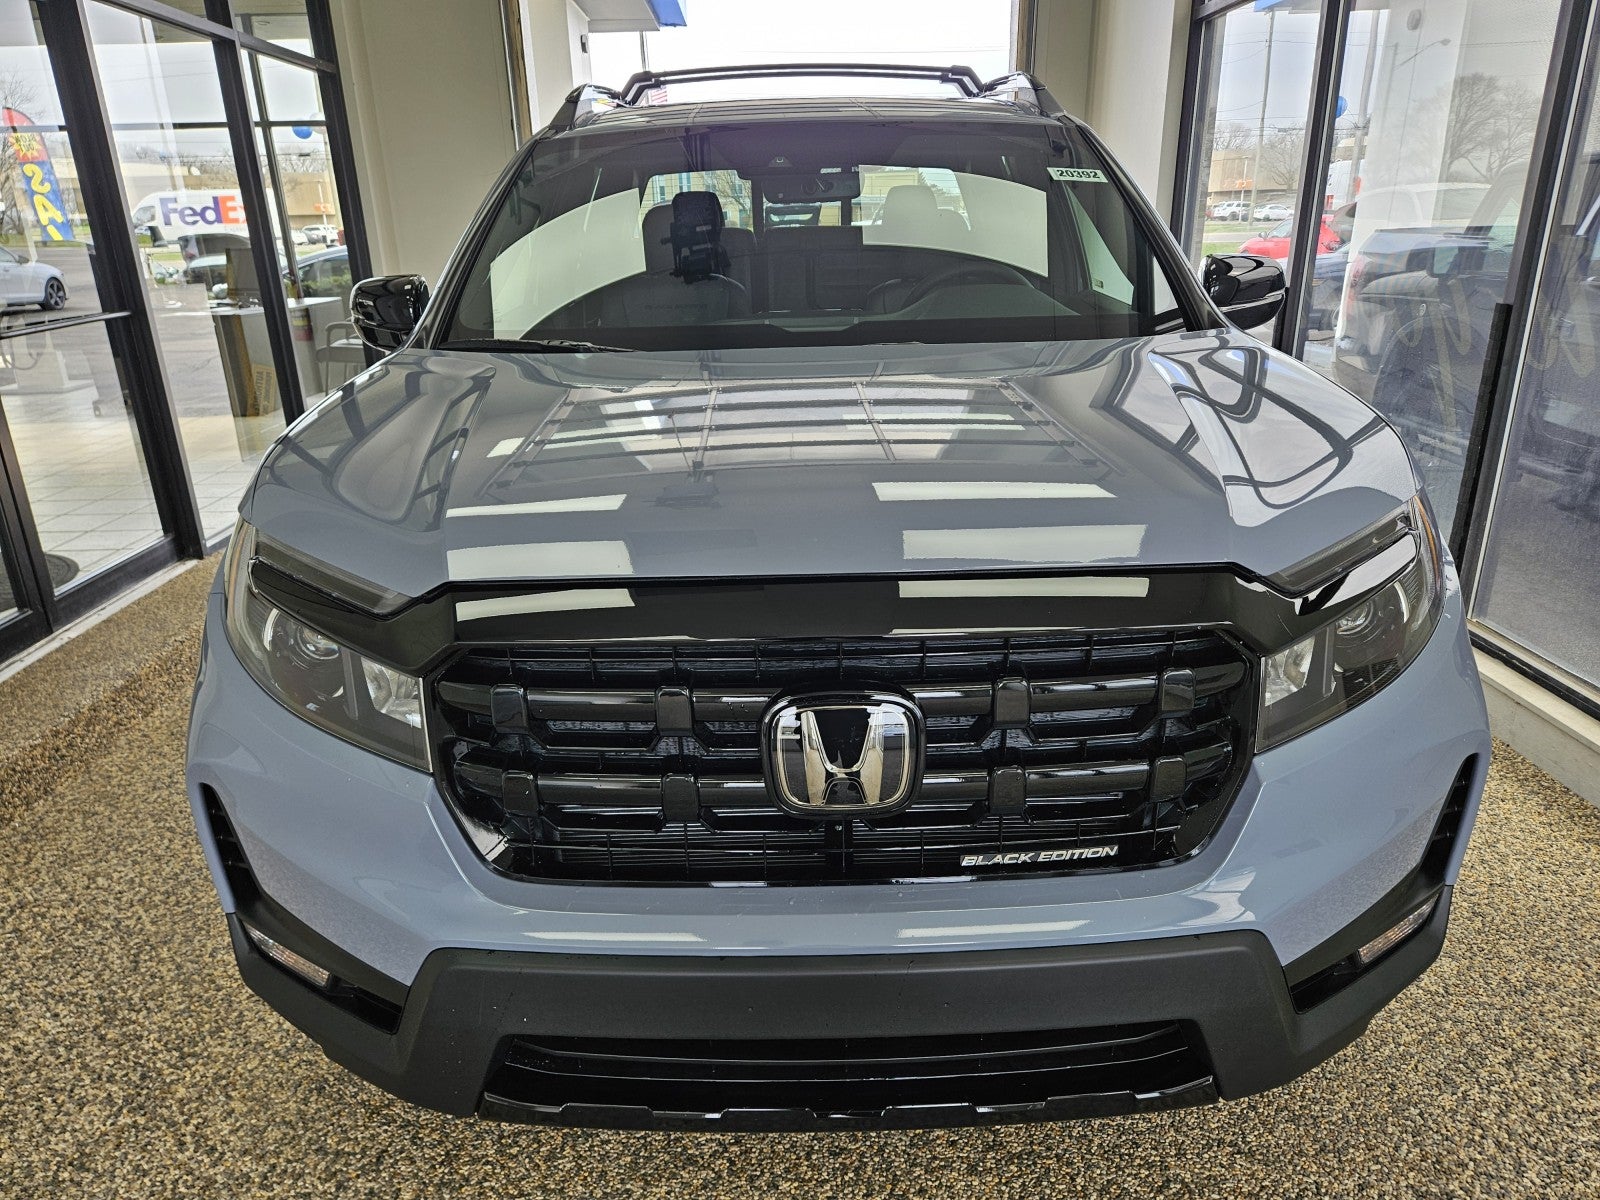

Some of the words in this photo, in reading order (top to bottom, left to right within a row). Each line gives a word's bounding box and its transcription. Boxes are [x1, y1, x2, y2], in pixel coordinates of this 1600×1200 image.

[1056, 169, 1100, 179] 20392
[961, 852, 1036, 867] BLACK
[1037, 845, 1119, 862] EDITION
